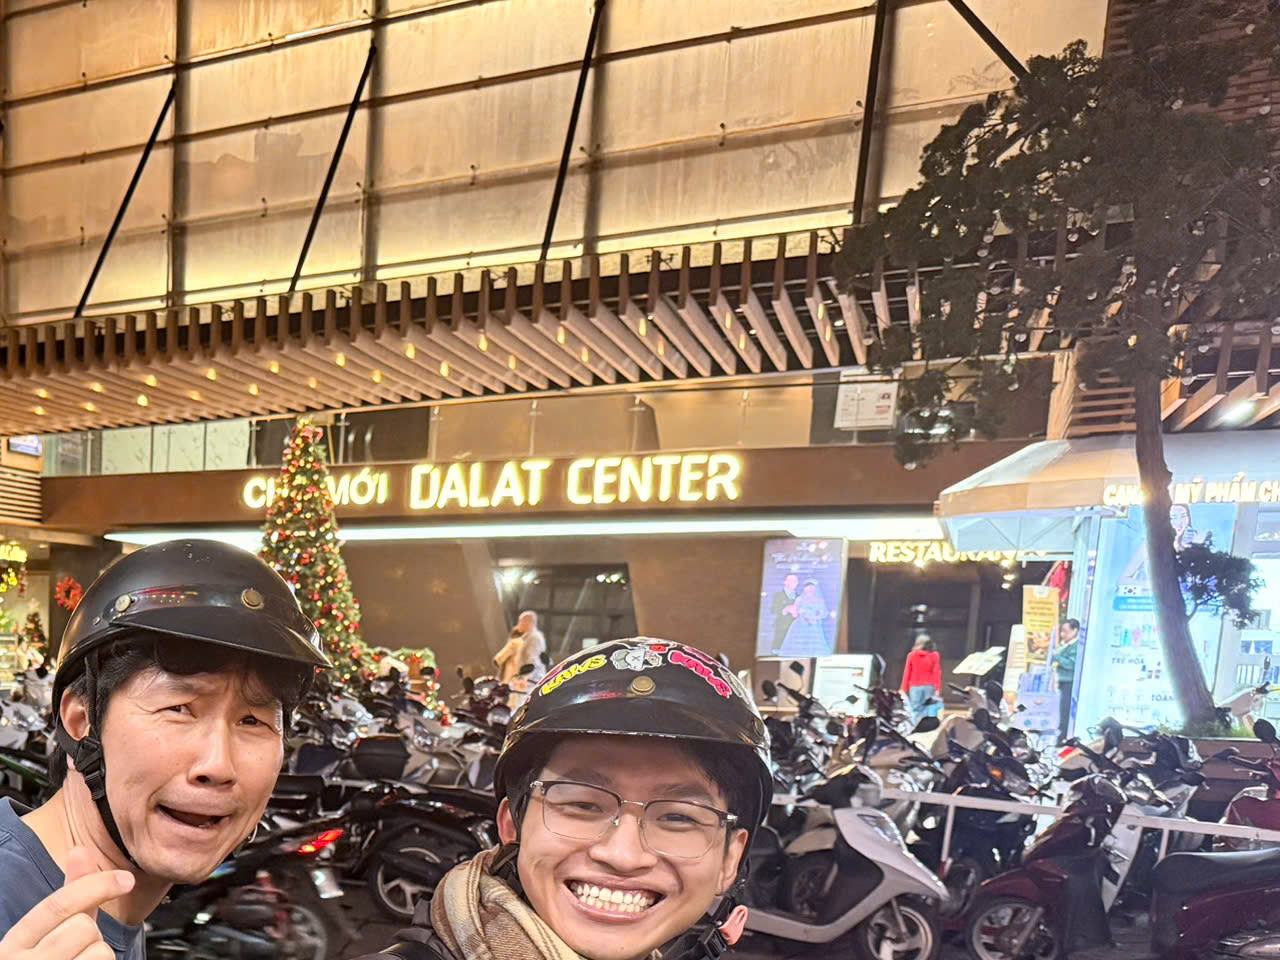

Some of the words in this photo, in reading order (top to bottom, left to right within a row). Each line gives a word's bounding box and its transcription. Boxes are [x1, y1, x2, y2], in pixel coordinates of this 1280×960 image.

[324, 467, 389, 505] MỚI
[409, 458, 551, 510] DALAT
[566, 455, 742, 504] CENTER
